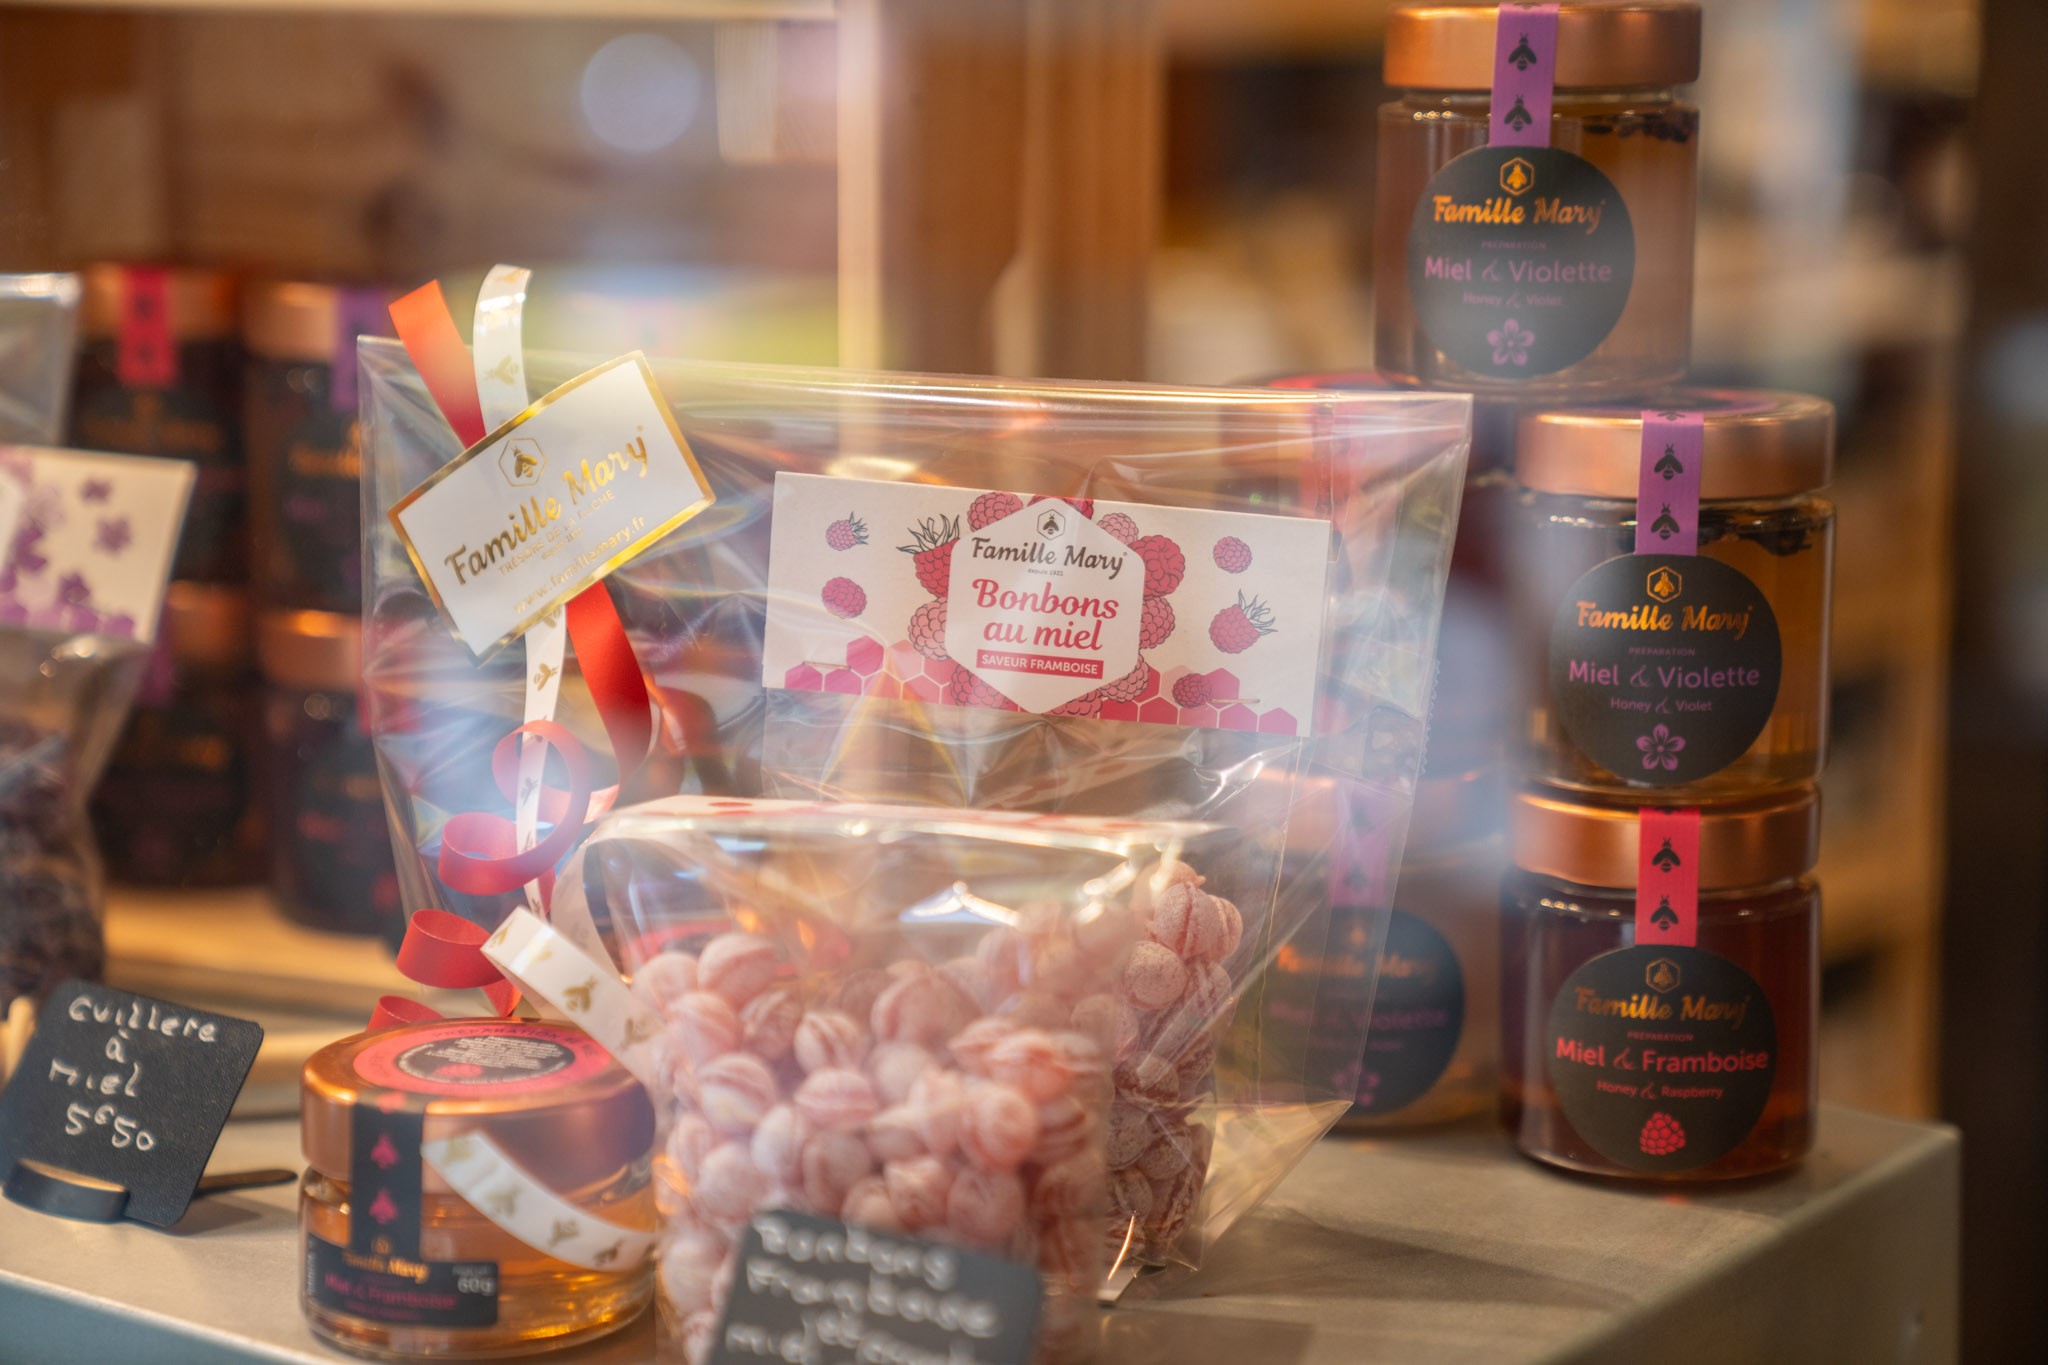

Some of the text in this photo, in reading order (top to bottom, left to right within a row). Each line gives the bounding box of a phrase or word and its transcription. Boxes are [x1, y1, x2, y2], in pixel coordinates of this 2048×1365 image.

[1432, 195, 1601, 235] Famille Mary
[1424, 256, 1613, 283] Miel & Violette
[1463, 292, 1502, 308] Honey
[444, 495, 562, 586] Famille
[562, 434, 648, 506] Mary
[971, 536, 1123, 580] Famille Mary
[972, 578, 1119, 619] Bonbons
[983, 619, 1103, 651] au miel
[1576, 601, 1750, 640] Famille Mary
[981, 654, 1098, 675] SAVEUR FRAMBOISE
[1569, 660, 1761, 688] Miel & Violette
[1610, 697, 1652, 713] Honey
[1675, 699, 1713, 712] Violet
[1575, 986, 1749, 1030] Famille Mary
[1556, 1037, 1769, 1073] Miel & Framboise
[1596, 1080, 1638, 1097] Honey
[1661, 1085, 1725, 1100] Raspberry
